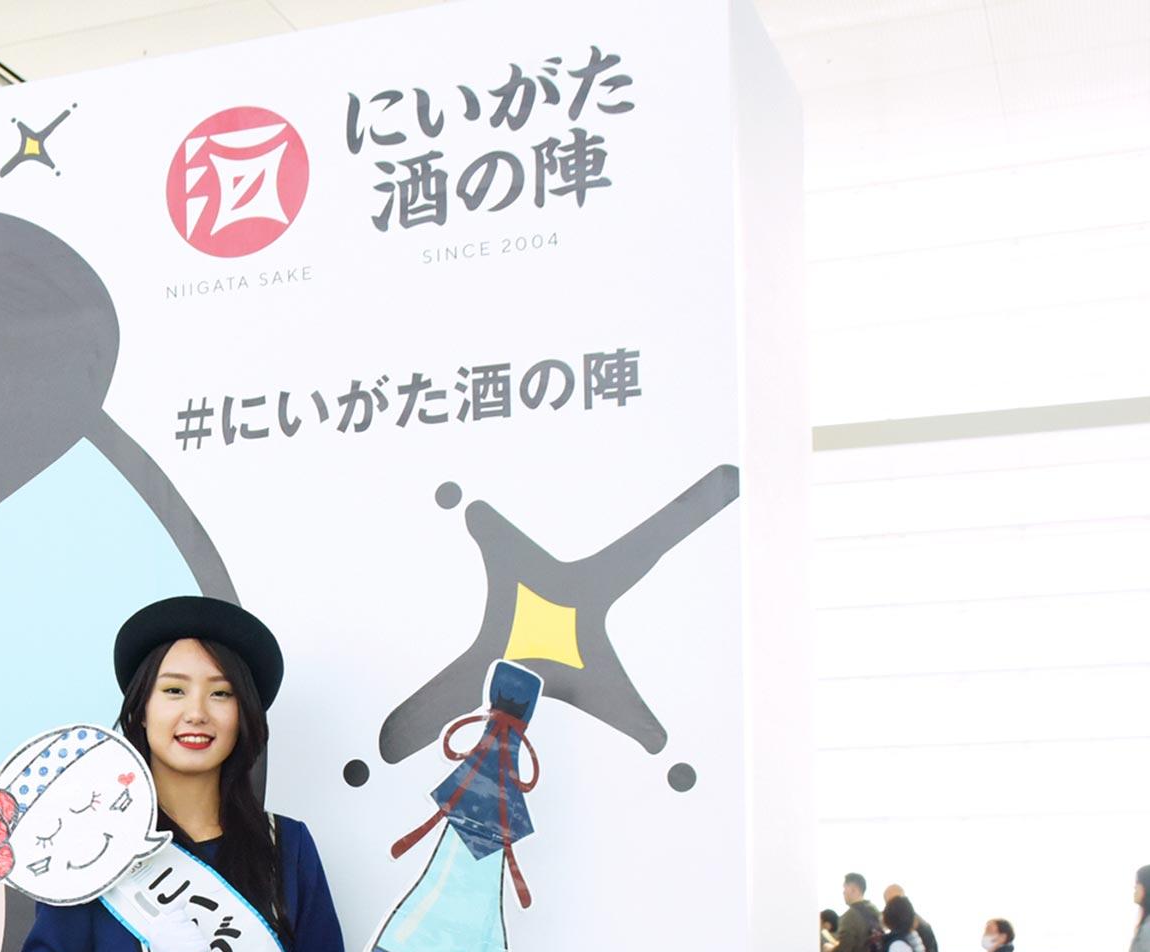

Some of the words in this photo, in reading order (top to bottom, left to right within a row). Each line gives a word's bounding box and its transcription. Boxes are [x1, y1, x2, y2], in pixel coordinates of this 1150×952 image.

[346, 45, 636, 155] にいがた
[370, 127, 613, 232] 酒の陣
[165, 274, 249, 299] NIIGATA
[258, 265, 313, 287] SAKE
[421, 241, 491, 265] SINCE
[501, 231, 559, 254] 2004
[175, 347, 643, 452] #にいがた酒の陣
